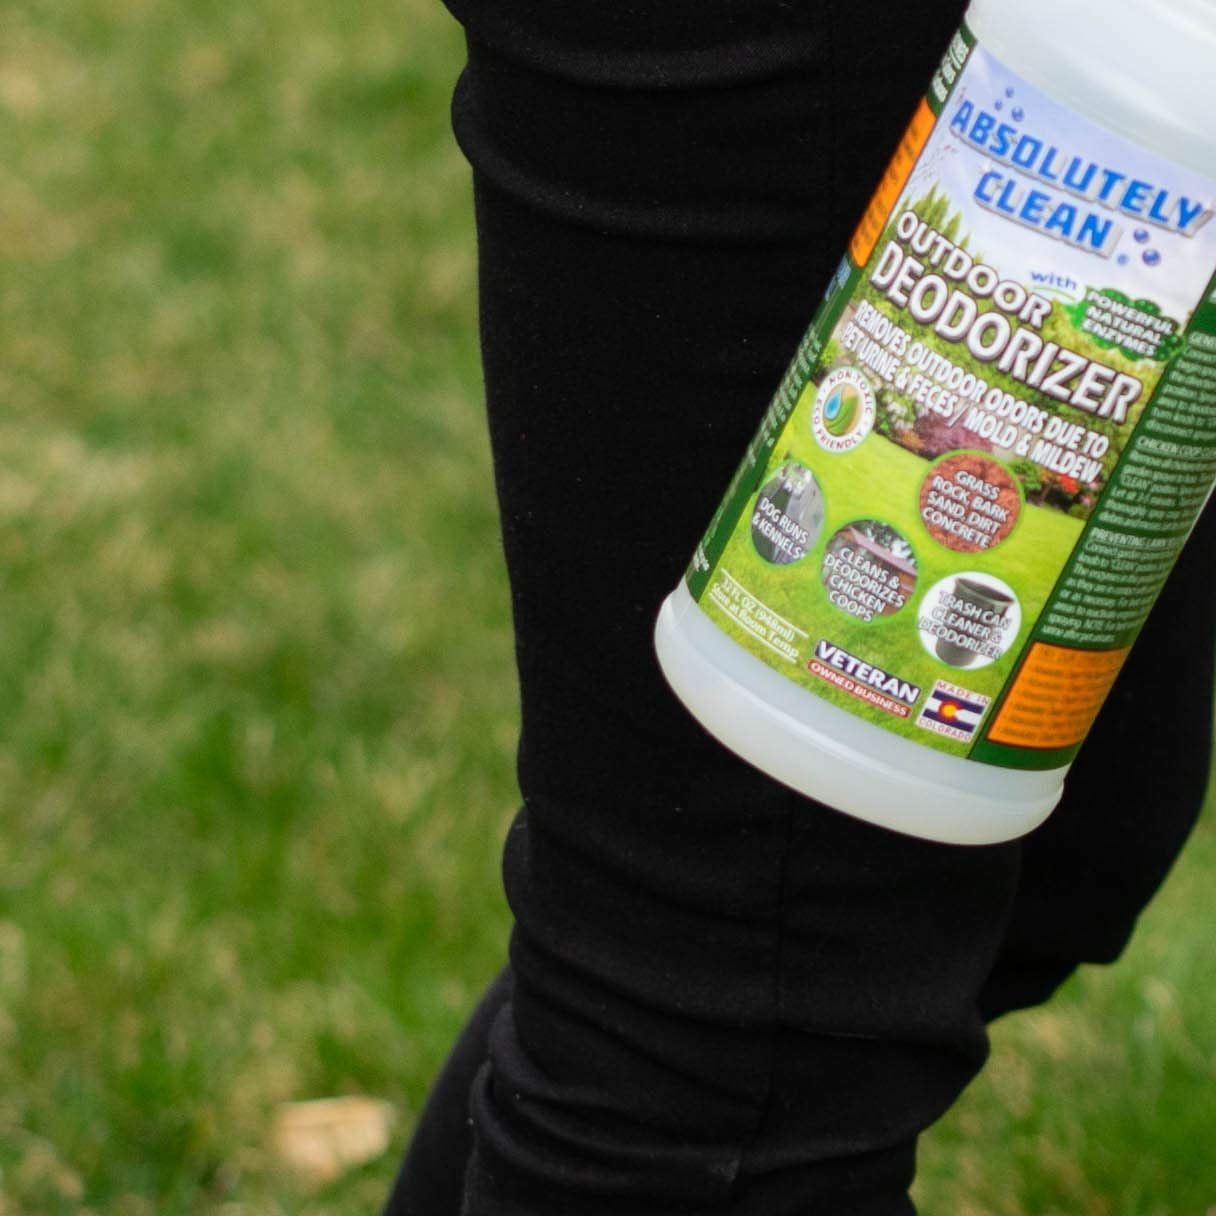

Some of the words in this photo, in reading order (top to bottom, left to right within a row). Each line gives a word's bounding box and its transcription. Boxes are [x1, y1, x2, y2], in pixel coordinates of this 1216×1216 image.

[951, 100, 1207, 231] ABSOLUTELY
[974, 170, 1114, 251] CLEAN
[897, 210, 1053, 329] OUTDOOR
[1031, 271, 1077, 291] with
[871, 240, 1143, 424] DEODORIZER
[1086, 305, 1161, 346] NATURAL
[1087, 290, 1173, 334] POWERFUL
[1082, 318, 1157, 357] ENZYMES
[854, 299, 912, 357] REMOVES
[906, 341, 987, 404] OUTDOOR
[984, 387, 1049, 434] ODORS
[1045, 415, 1084, 450] DUE
[1082, 429, 1109, 459] TO
[844, 320, 868, 353] PET
[858, 340, 900, 382] URINE
[895, 367, 911, 390] &
[907, 375, 959, 418] FECES
[963, 407, 1018, 449] MOLD
[1015, 435, 1032, 458] &
[1028, 439, 1103, 483] MILDEW
[955, 470, 1000, 500] GRASS
[752, 512, 761, 525] &
[760, 497, 781, 523] DOG
[779, 515, 808, 544] RUNS
[922, 507, 992, 549] CONCRETE
[967, 512, 1001, 534] DIRT
[971, 496, 1009, 523] BARK
[824, 553, 905, 608] DEODORIZES
[841, 548, 889, 583] CLEANS
[888, 576, 900, 590] &
[741, 597, 756, 613] OZ
[829, 574, 886, 613] CHICKEN
[829, 590, 874, 622] COOPS
[939, 591, 982, 620] TRASH
[767, 630, 800, 657] Temp
[918, 616, 1003, 661] DEODORIZER
[931, 607, 991, 640] CLEANER
[811, 662, 855, 690] OWNED
[853, 684, 908, 717] BUSINESS
[818, 640, 920, 705] VETERAN
[936, 680, 972, 699] MADE
[976, 694, 991, 705] IN
[919, 718, 972, 743] COLORADO
